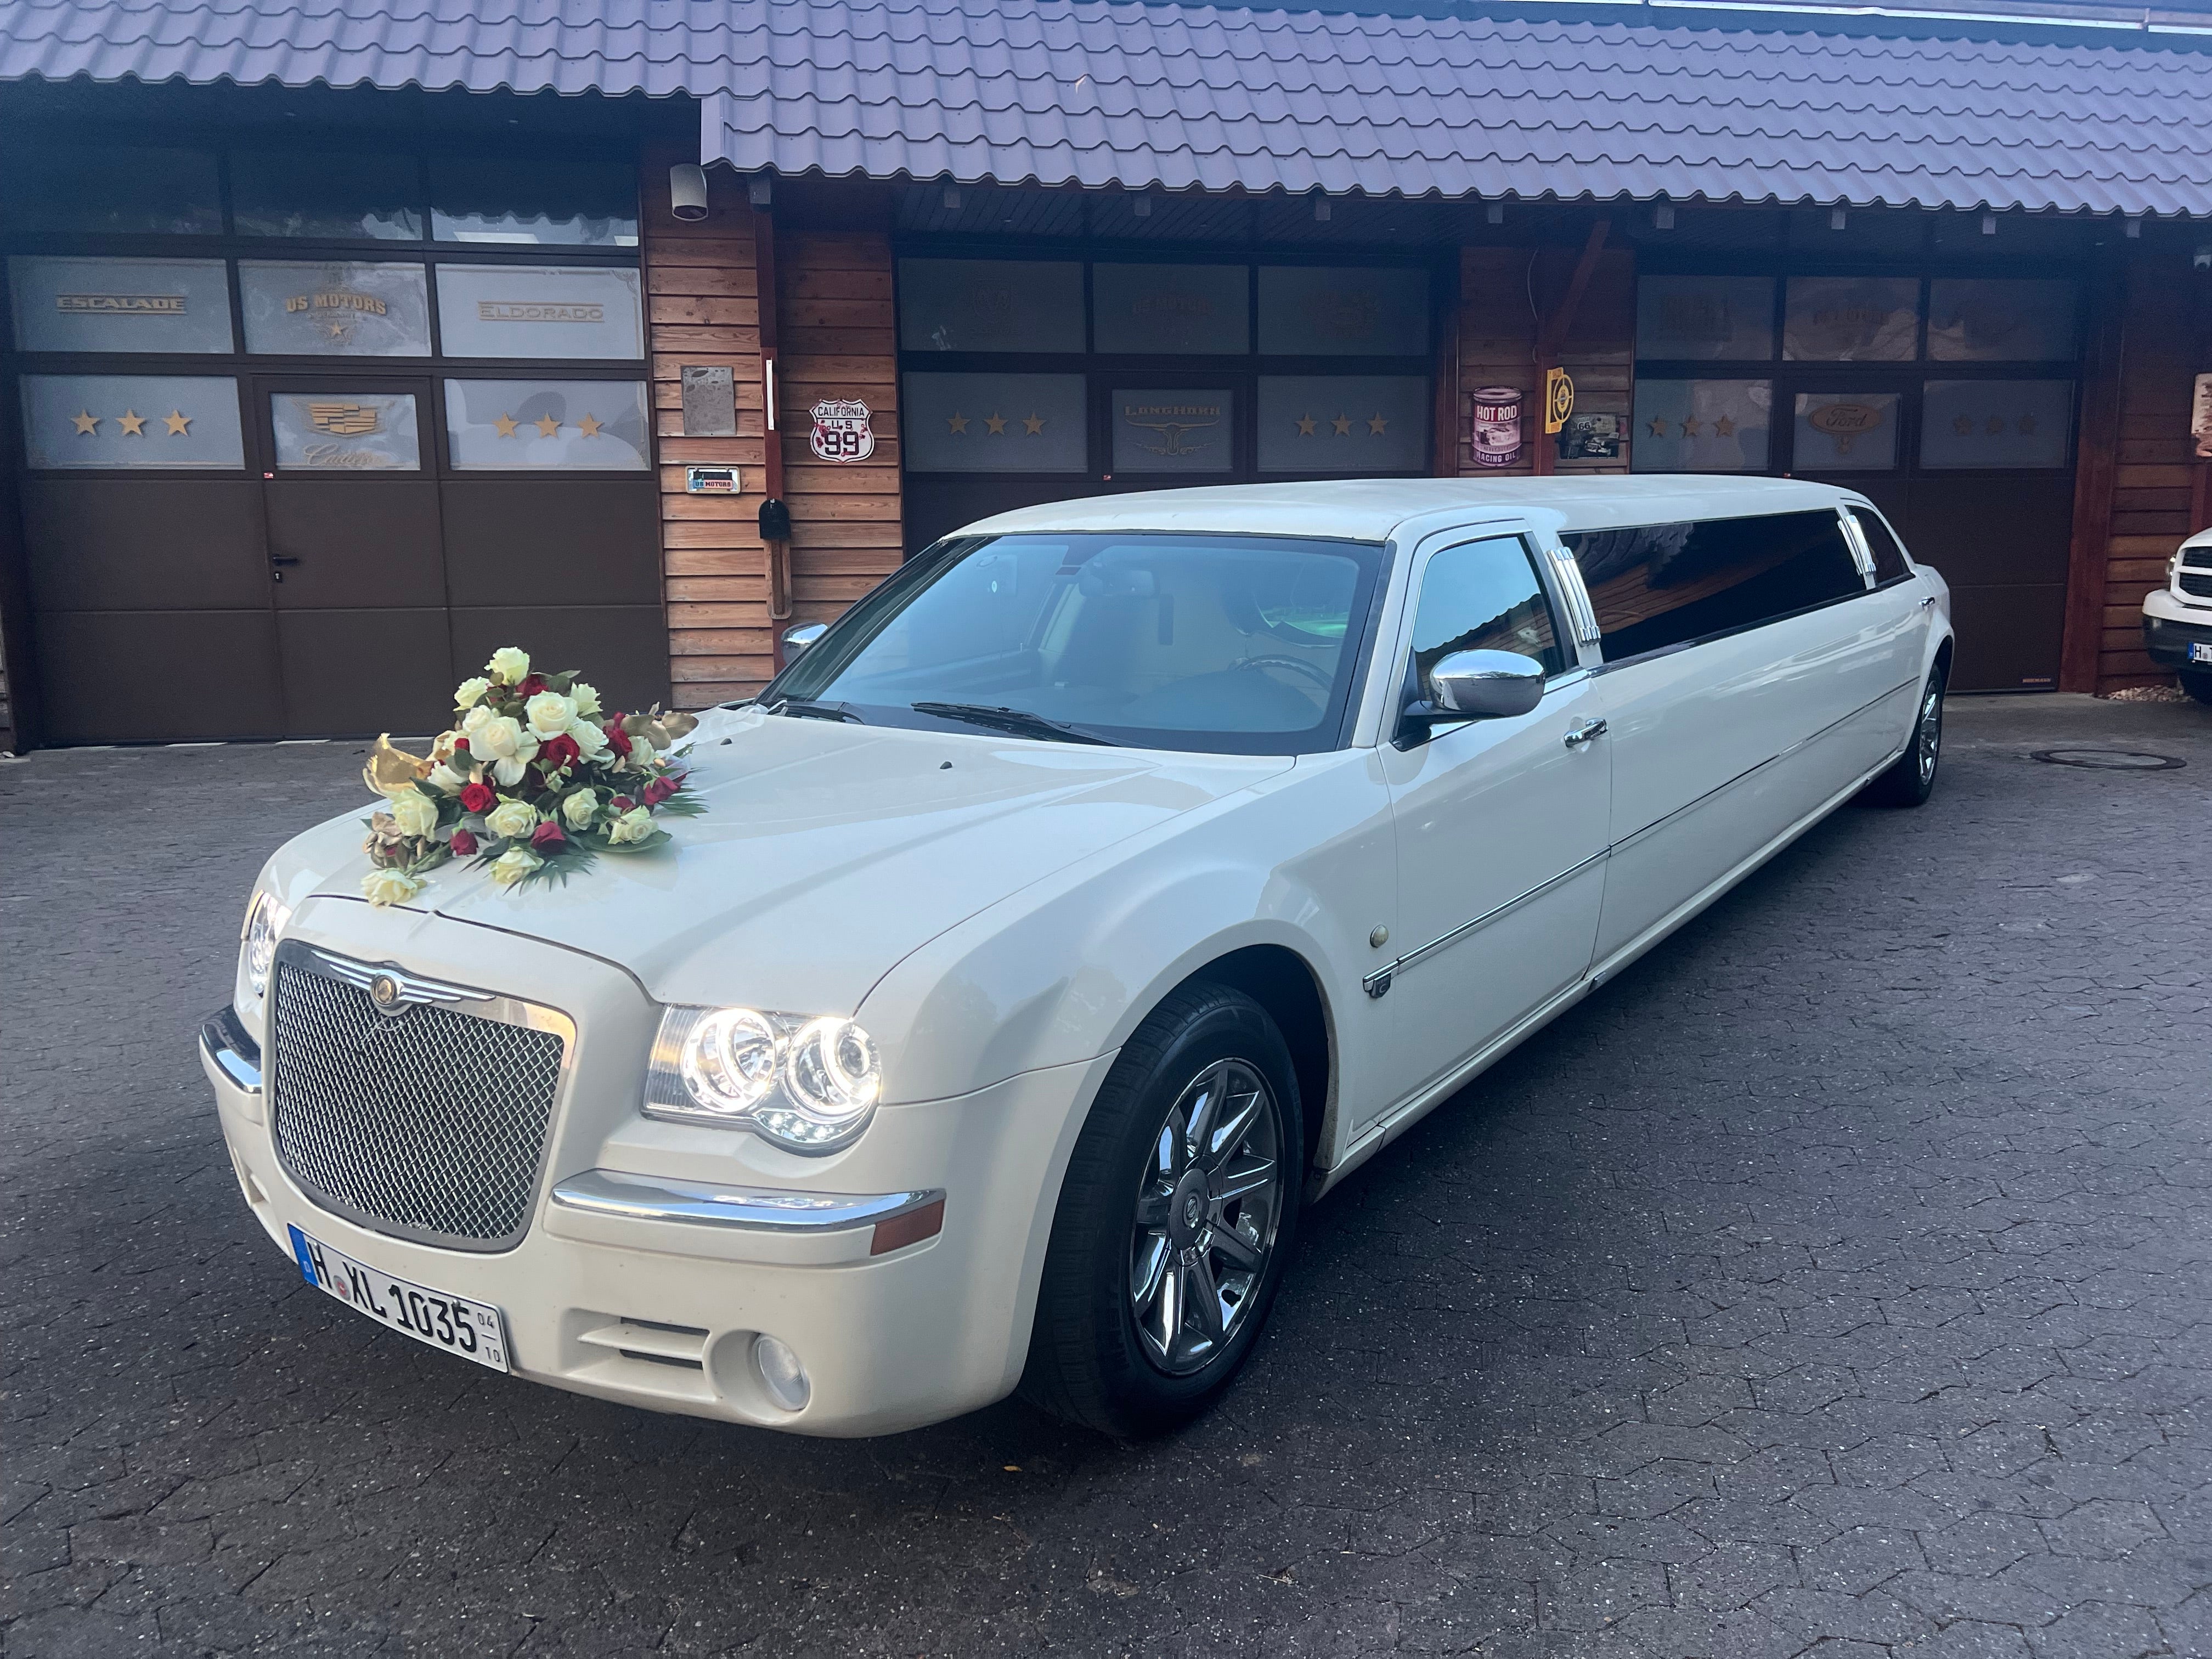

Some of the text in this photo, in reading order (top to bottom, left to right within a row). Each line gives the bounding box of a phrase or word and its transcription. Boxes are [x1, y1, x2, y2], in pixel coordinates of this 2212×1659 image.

[56, 297, 185, 311] ESCALADE
[285, 292, 387, 316] US MOTORS
[479, 305, 603, 319] ELDORADO
[818, 407, 865, 417] CALIFORNIA
[1476, 405, 1517, 421] HOT ROD
[1826, 408, 1868, 426] Ford
[1578, 421, 1591, 431] 66
[824, 431, 860, 455] 99
[1476, 450, 1516, 463] RACING OIL
[2194, 645, 2202, 658] H
[307, 1241, 477, 1353] H XL 1035
[485, 1346, 501, 1363] 10
